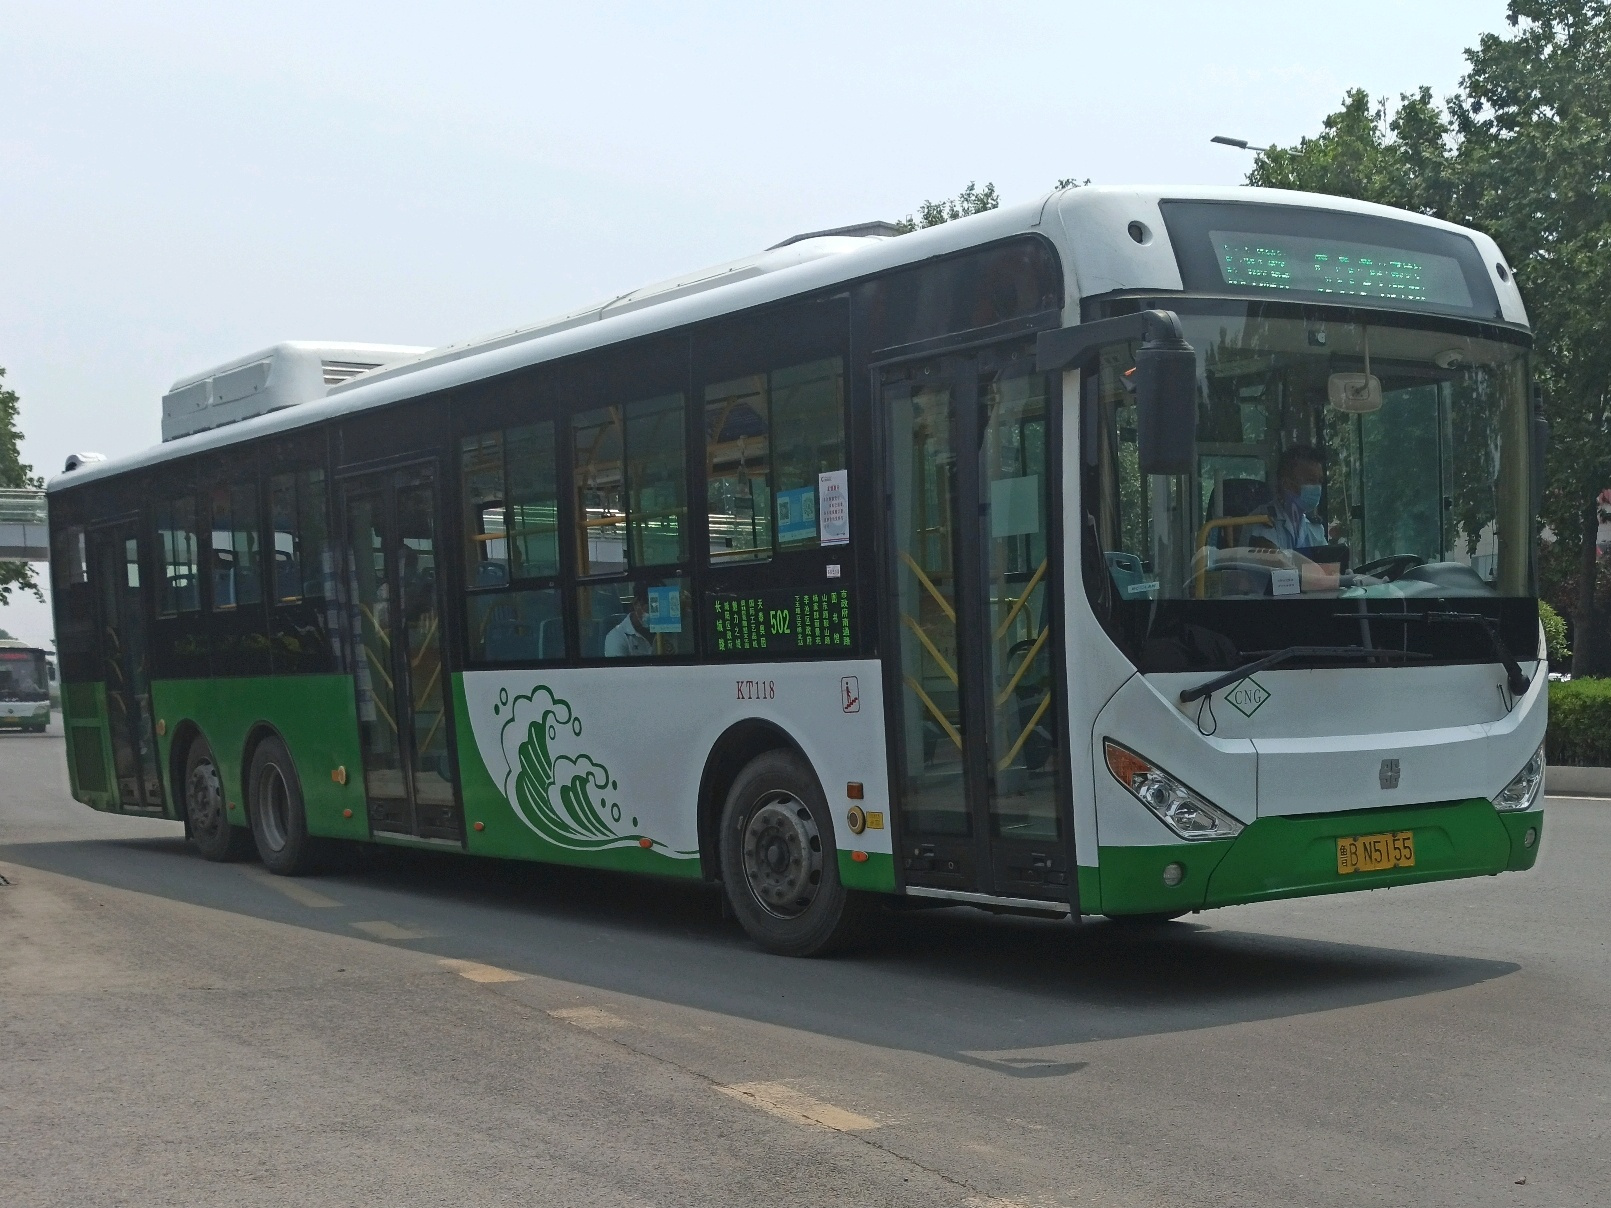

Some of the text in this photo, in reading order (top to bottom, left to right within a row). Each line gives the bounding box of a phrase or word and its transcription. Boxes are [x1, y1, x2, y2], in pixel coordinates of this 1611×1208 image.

[769, 609, 791, 635] 502
[831, 592, 840, 644] 图书馆
[736, 680, 775, 700] KT118
[1234, 688, 1262, 705] CNG
[1363, 836, 1413, 866] N5155
